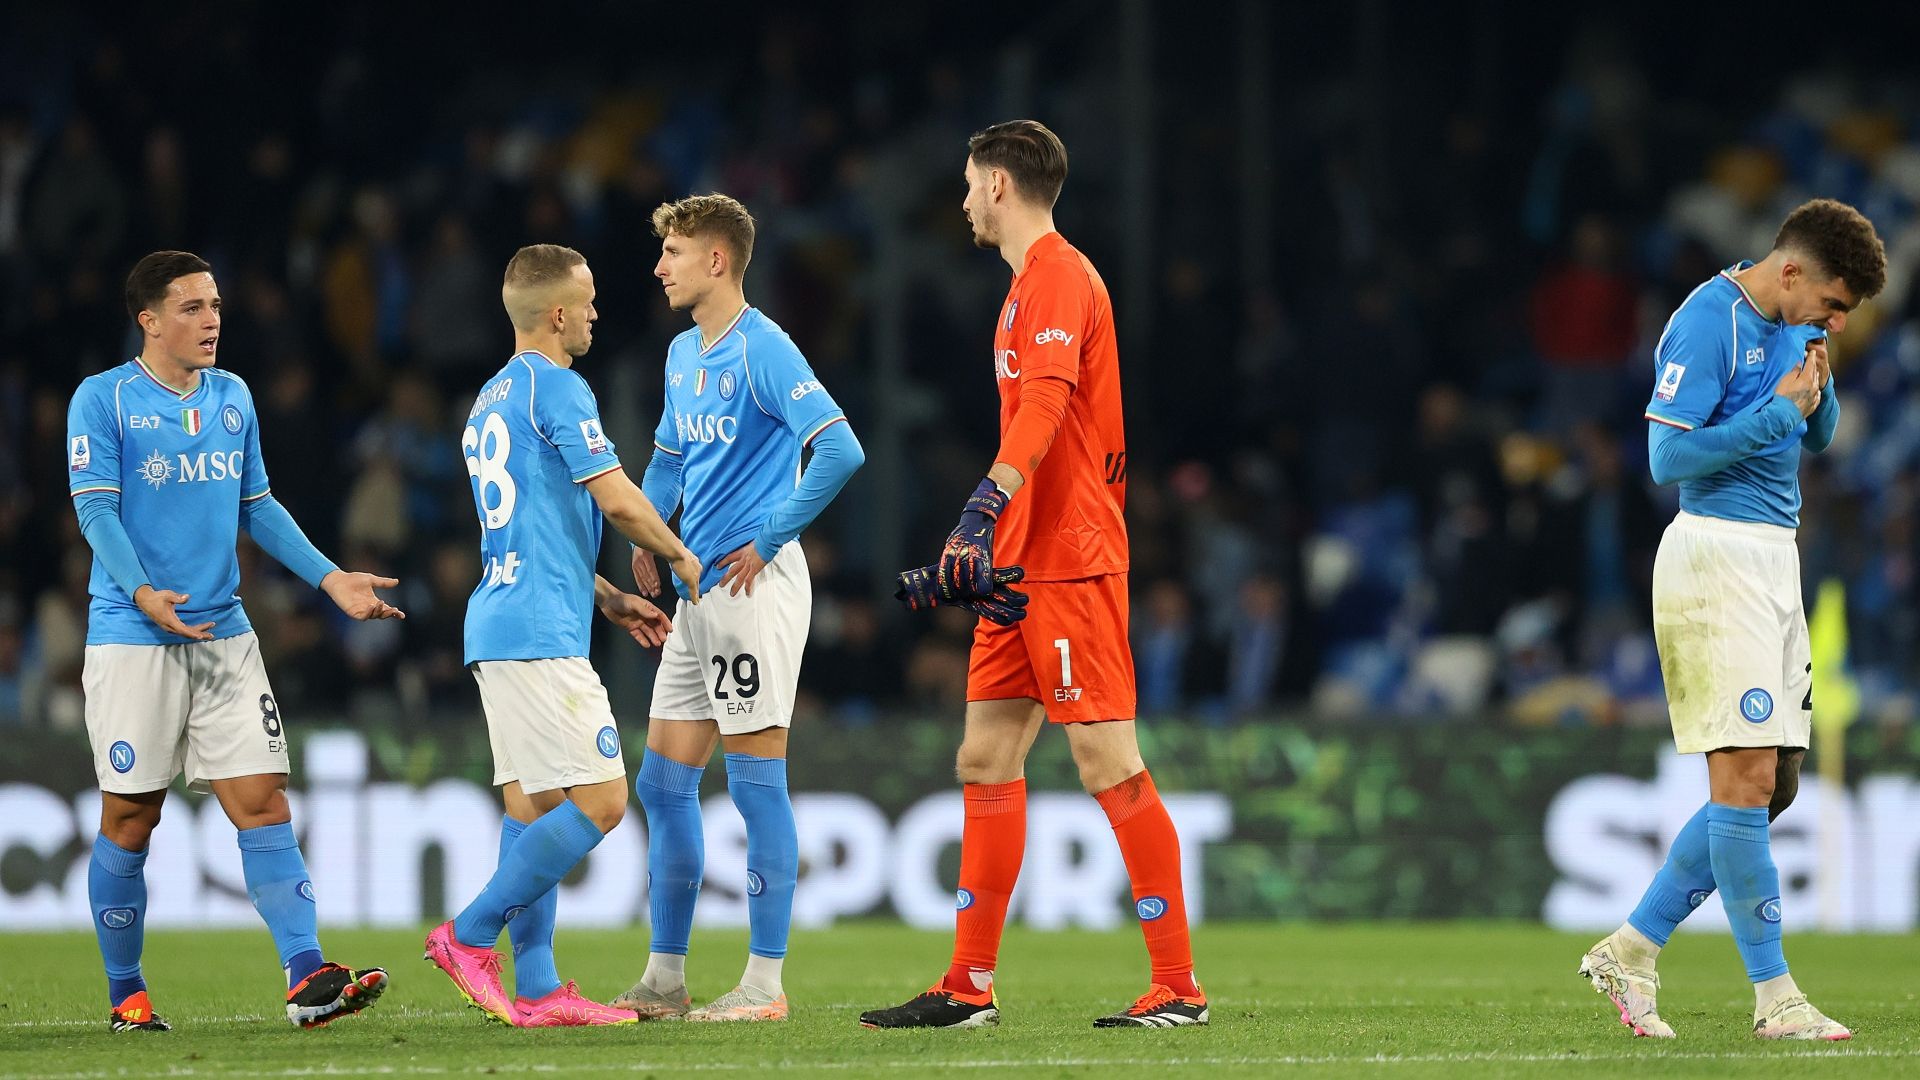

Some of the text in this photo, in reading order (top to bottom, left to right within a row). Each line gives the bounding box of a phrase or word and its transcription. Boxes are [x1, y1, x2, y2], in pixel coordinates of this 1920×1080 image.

[1035, 327, 1074, 346] ebay
[1746, 347, 1765, 365] EA7
[723, 377, 731, 393] N
[790, 380, 825, 400] eba
[129, 415, 161, 430] EA7
[226, 412, 237, 429] N
[686, 413, 738, 445] MSC
[177, 450, 243, 483] MSC
[462, 412, 517, 530] 68
[1054, 639, 1072, 687] 1
[711, 653, 760, 699] 29
[1054, 688, 1083, 702] EA7
[259, 693, 281, 737] 8
[727, 700, 756, 715] EA7
[1749, 697, 1765, 715] N
[602, 734, 615, 751] N
[114, 749, 127, 766] N
